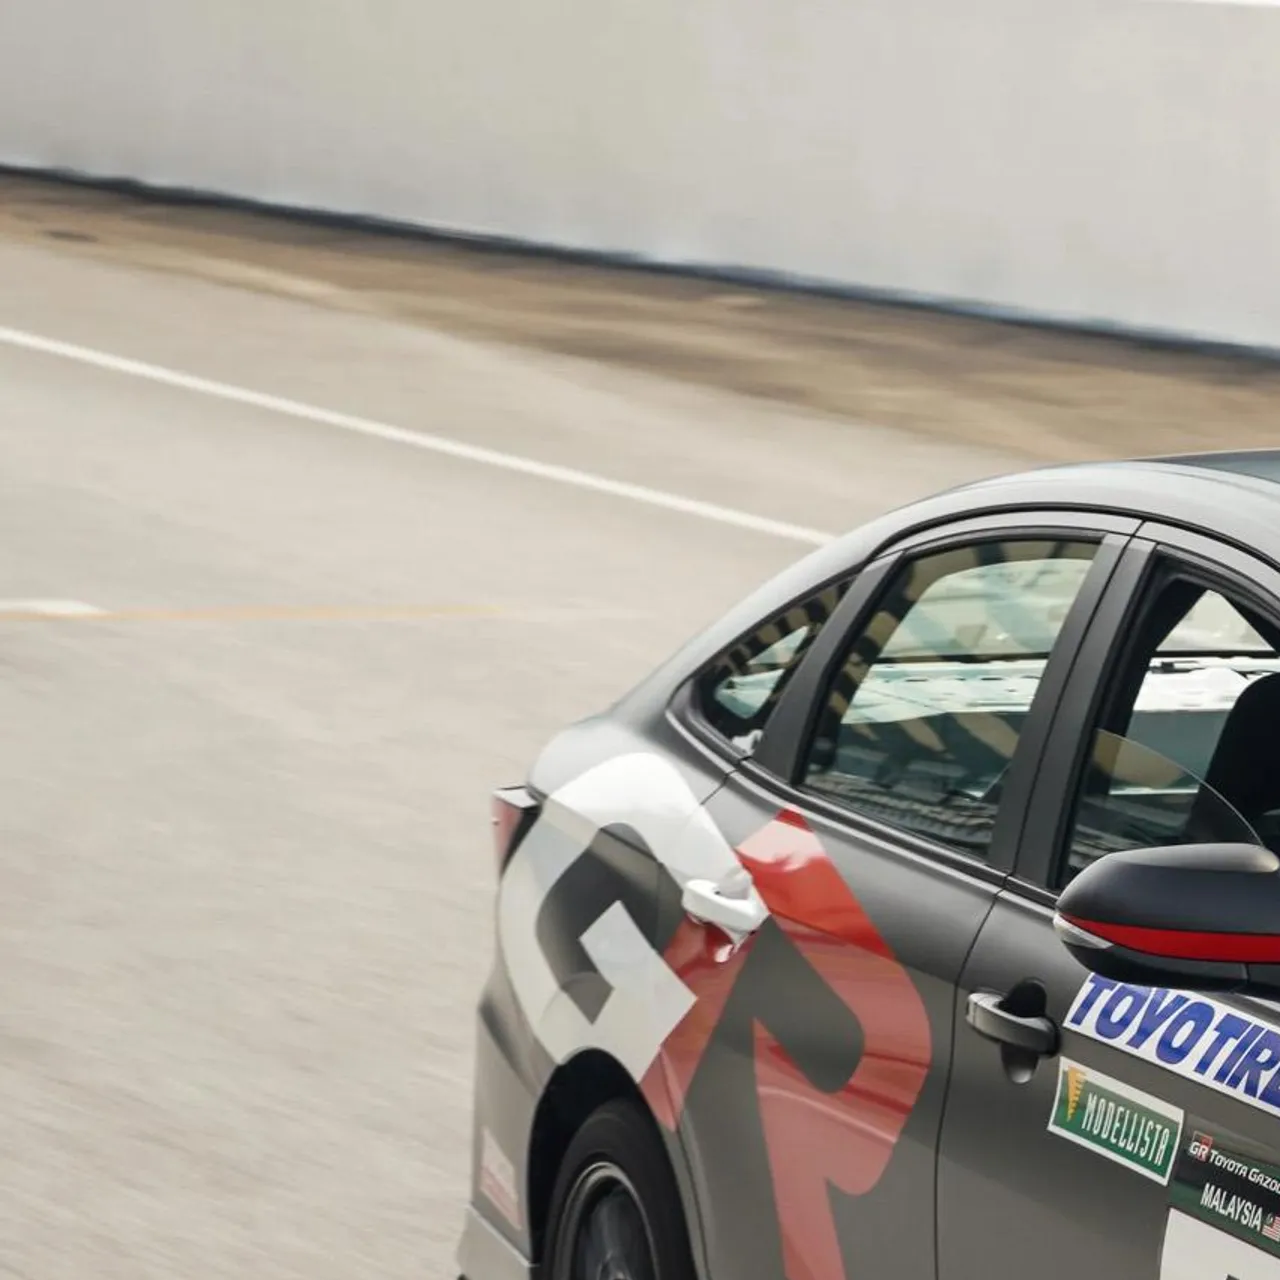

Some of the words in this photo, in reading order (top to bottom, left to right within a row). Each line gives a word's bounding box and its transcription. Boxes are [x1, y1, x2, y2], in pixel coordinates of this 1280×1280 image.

[1081, 1091, 1171, 1167] MODELLISTA
[1188, 1141, 1210, 1161] GR
[1209, 1149, 1249, 1178] TOYOTA
[1200, 1182, 1263, 1232] MALAYSIA
